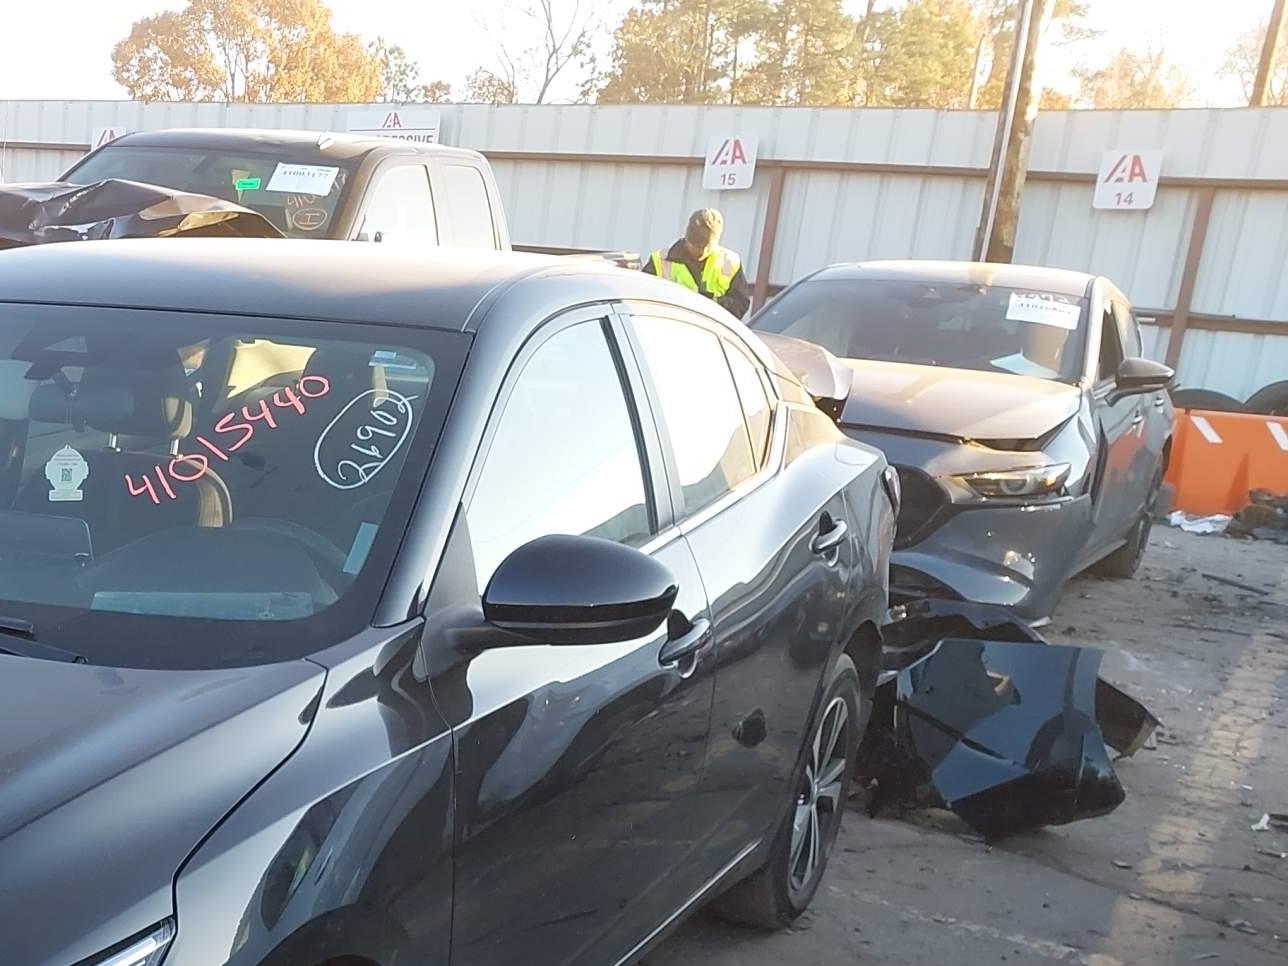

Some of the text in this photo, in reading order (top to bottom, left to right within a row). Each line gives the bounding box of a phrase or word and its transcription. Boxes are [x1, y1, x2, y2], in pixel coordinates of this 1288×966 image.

[721, 173, 737, 186] 15
[1115, 191, 1134, 206] 14
[125, 375, 330, 504] 41015440
